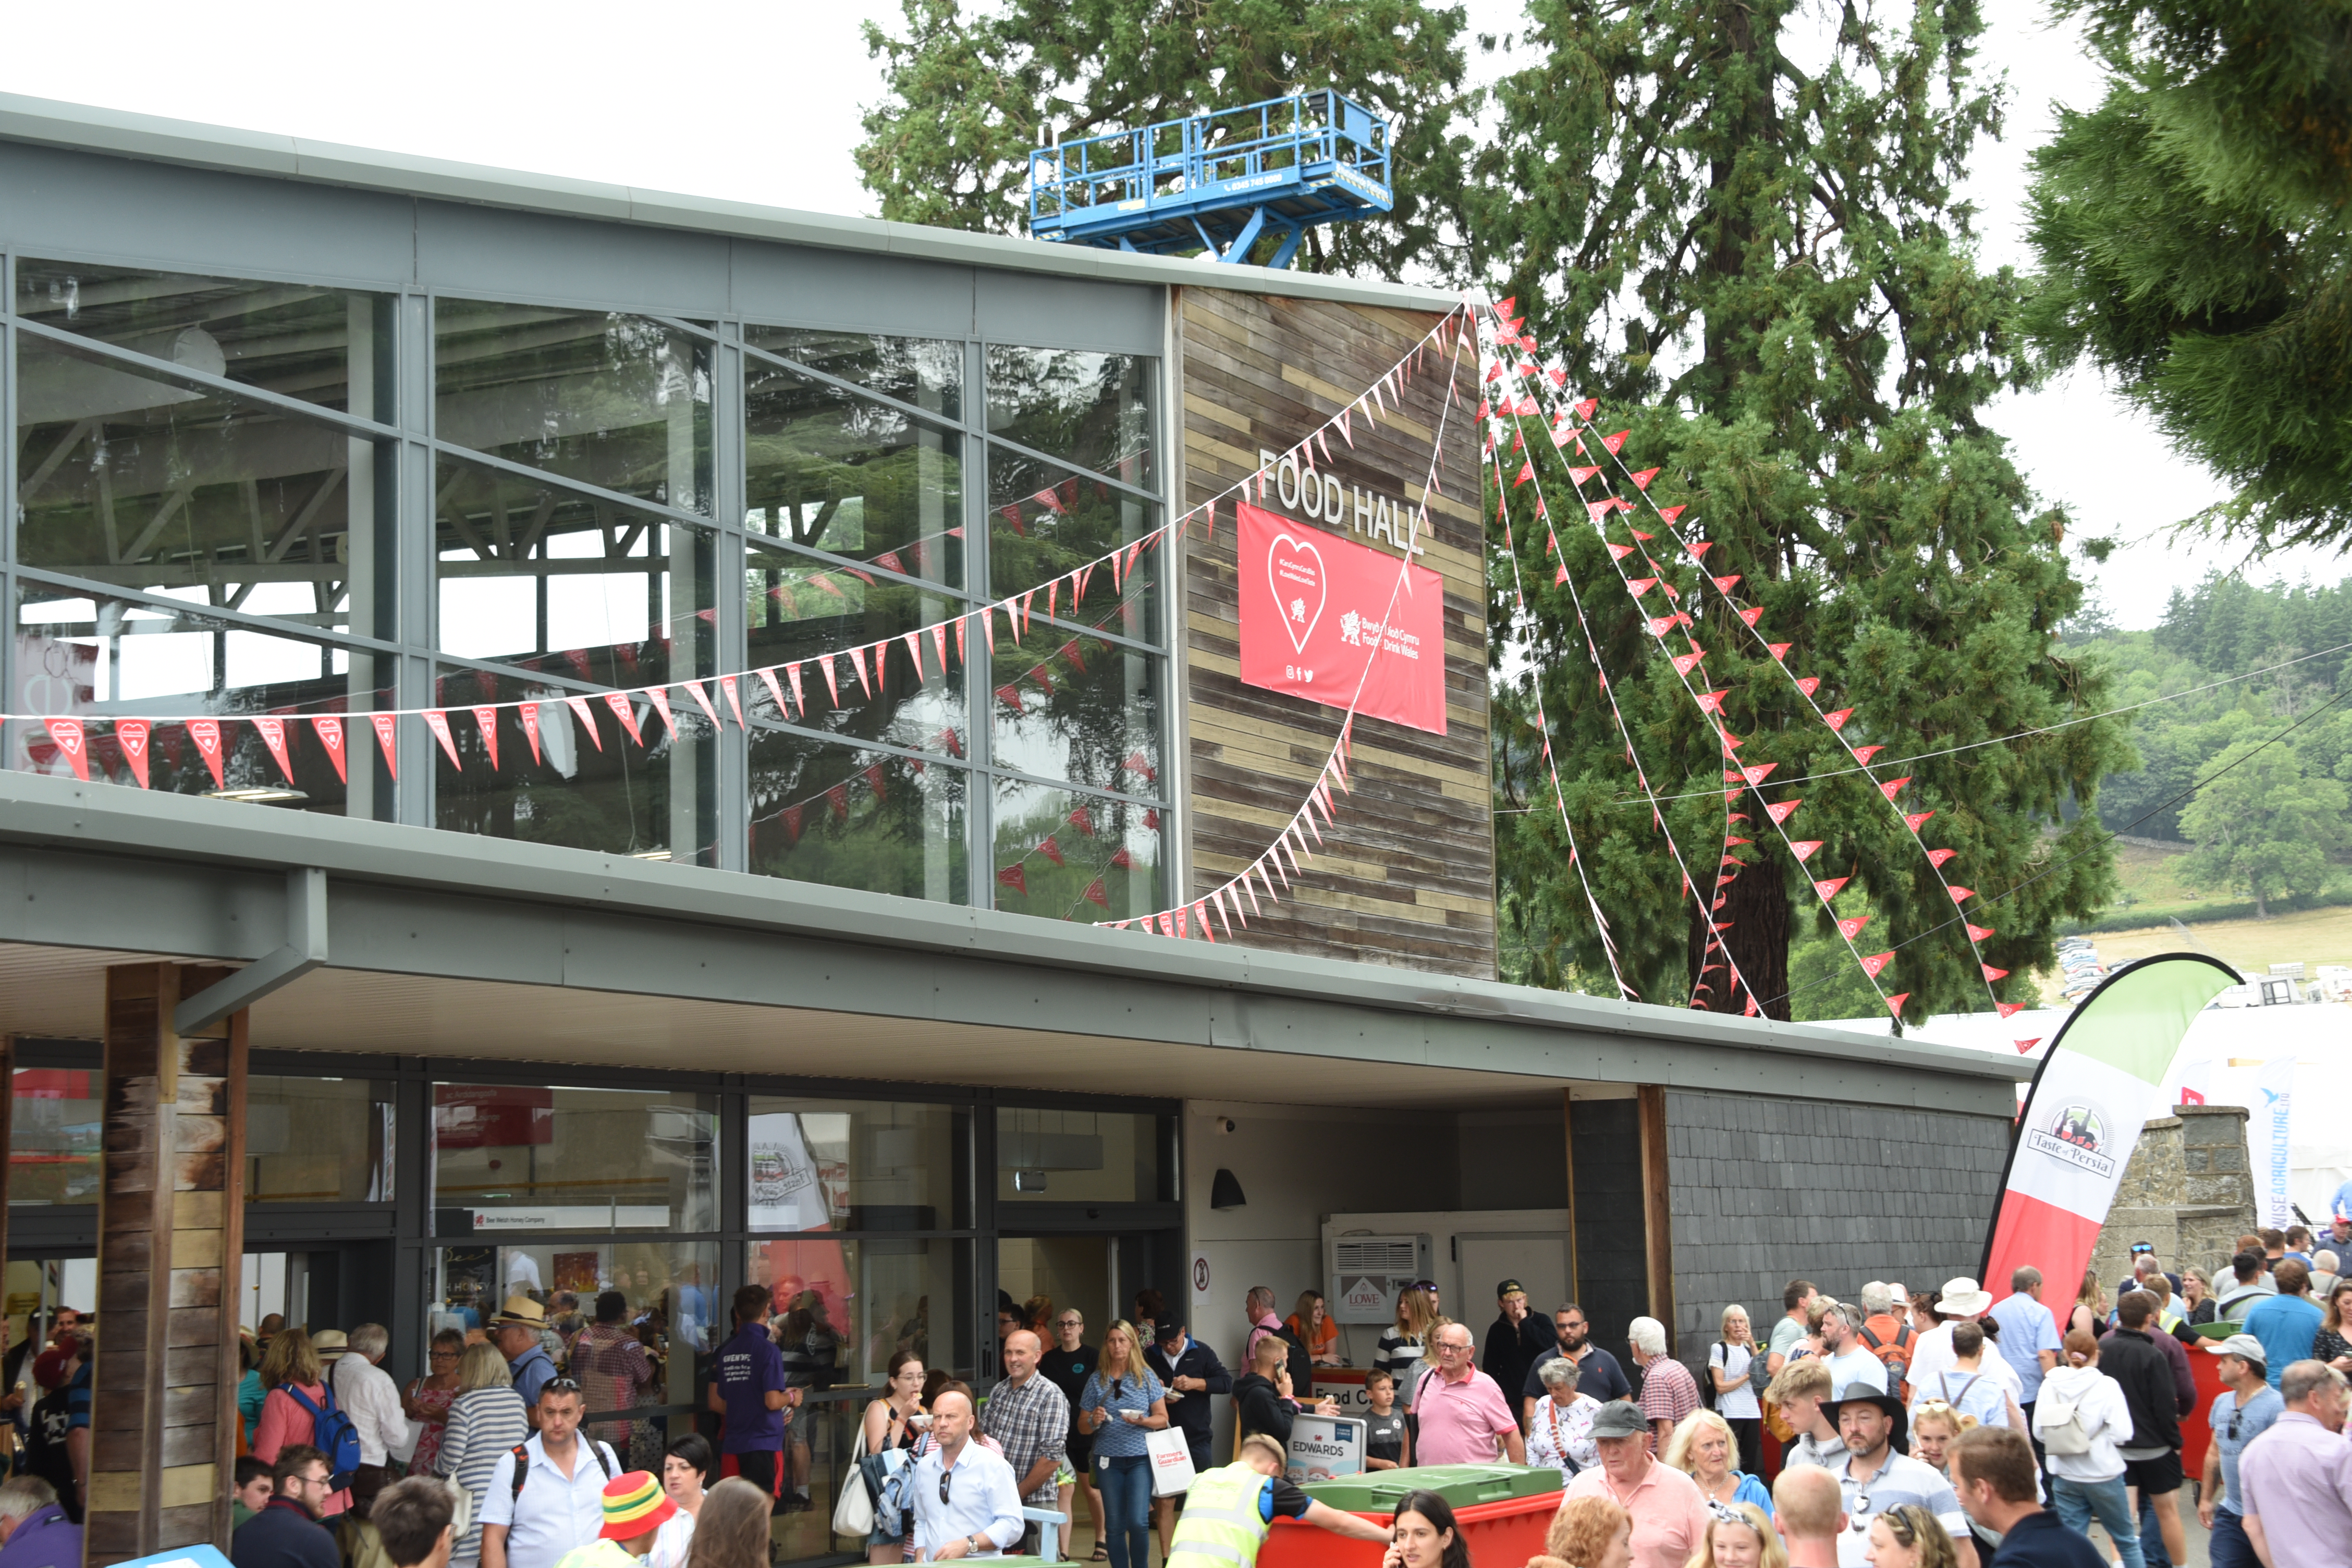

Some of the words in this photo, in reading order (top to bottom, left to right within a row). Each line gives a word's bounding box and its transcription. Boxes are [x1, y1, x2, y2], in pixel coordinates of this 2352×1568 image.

[1232, 179, 1250, 191] 0345
[1251, 177, 1264, 188] 745
[1265, 174, 1282, 185] 0000
[1260, 448, 1343, 524] FOOD
[1354, 485, 1424, 556] HALL
[1399, 629, 1419, 645] Cymru
[1384, 639, 1401, 654] Drink
[1400, 644, 1419, 659] Wales
[2034, 1134, 2062, 1154] Taste
[2070, 1147, 2109, 1172] Persia
[1349, 1294, 1380, 1304] LOWE
[1156, 1451, 1183, 1460] Farmers
[1293, 1441, 1344, 1457] EDWARDS
[1158, 1456, 1186, 1465] Guardian
